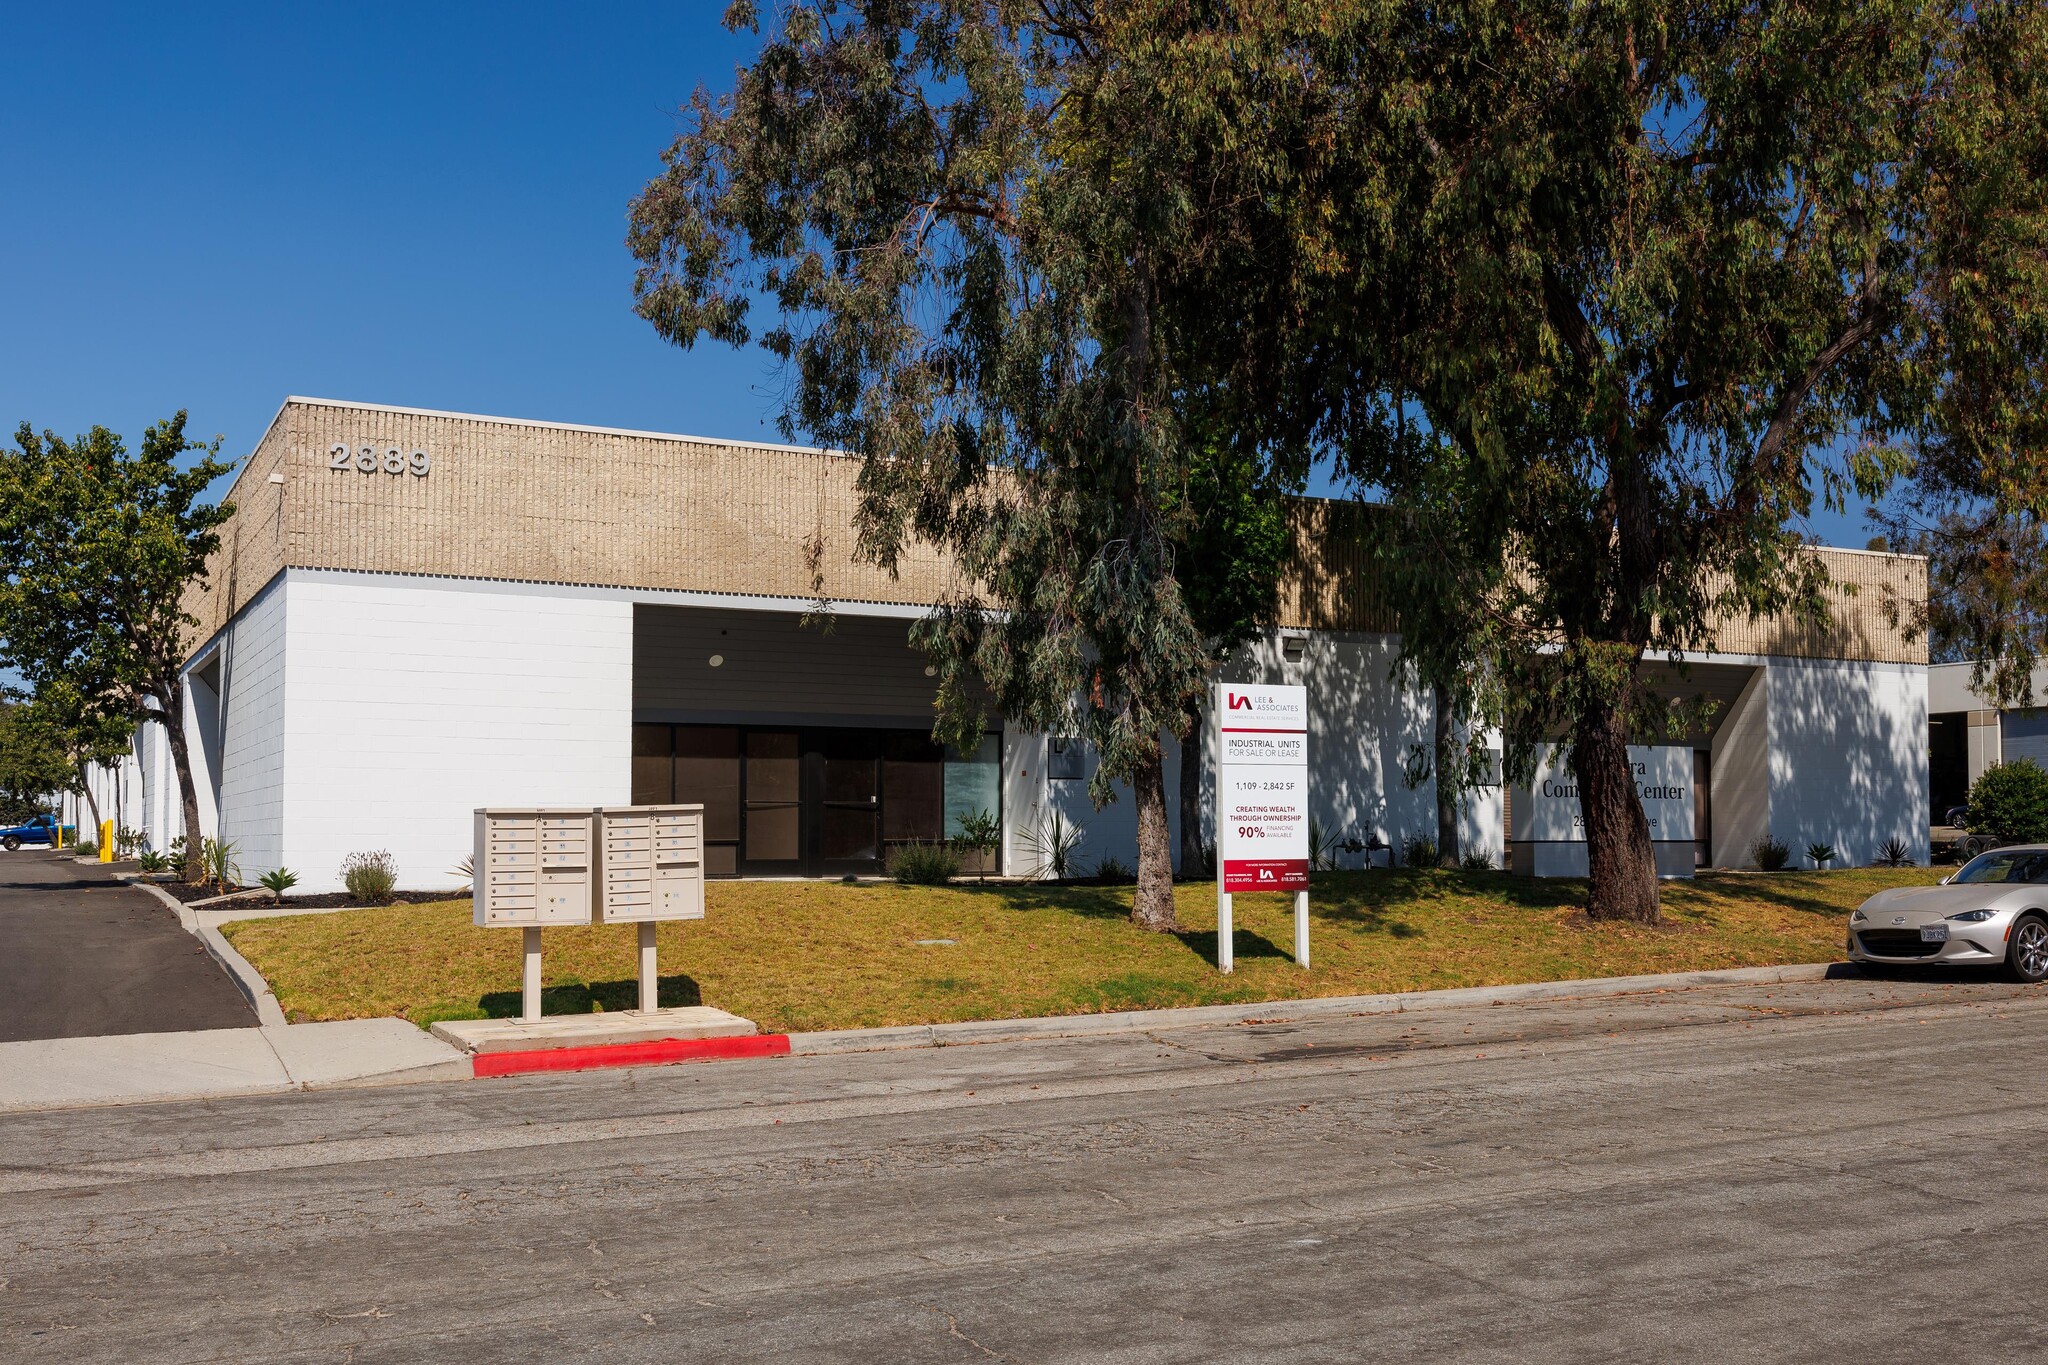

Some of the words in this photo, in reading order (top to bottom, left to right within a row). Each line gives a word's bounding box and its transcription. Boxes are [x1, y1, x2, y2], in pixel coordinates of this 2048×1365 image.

[329, 442, 431, 476] 2889
[1229, 740, 1274, 748] INDUSTRIAL
[1236, 782, 1257, 790] 1,109
[1264, 782, 1284, 790] 2,842
[1636, 781, 1685, 800] Center
[1238, 826, 1265, 838] 90%
